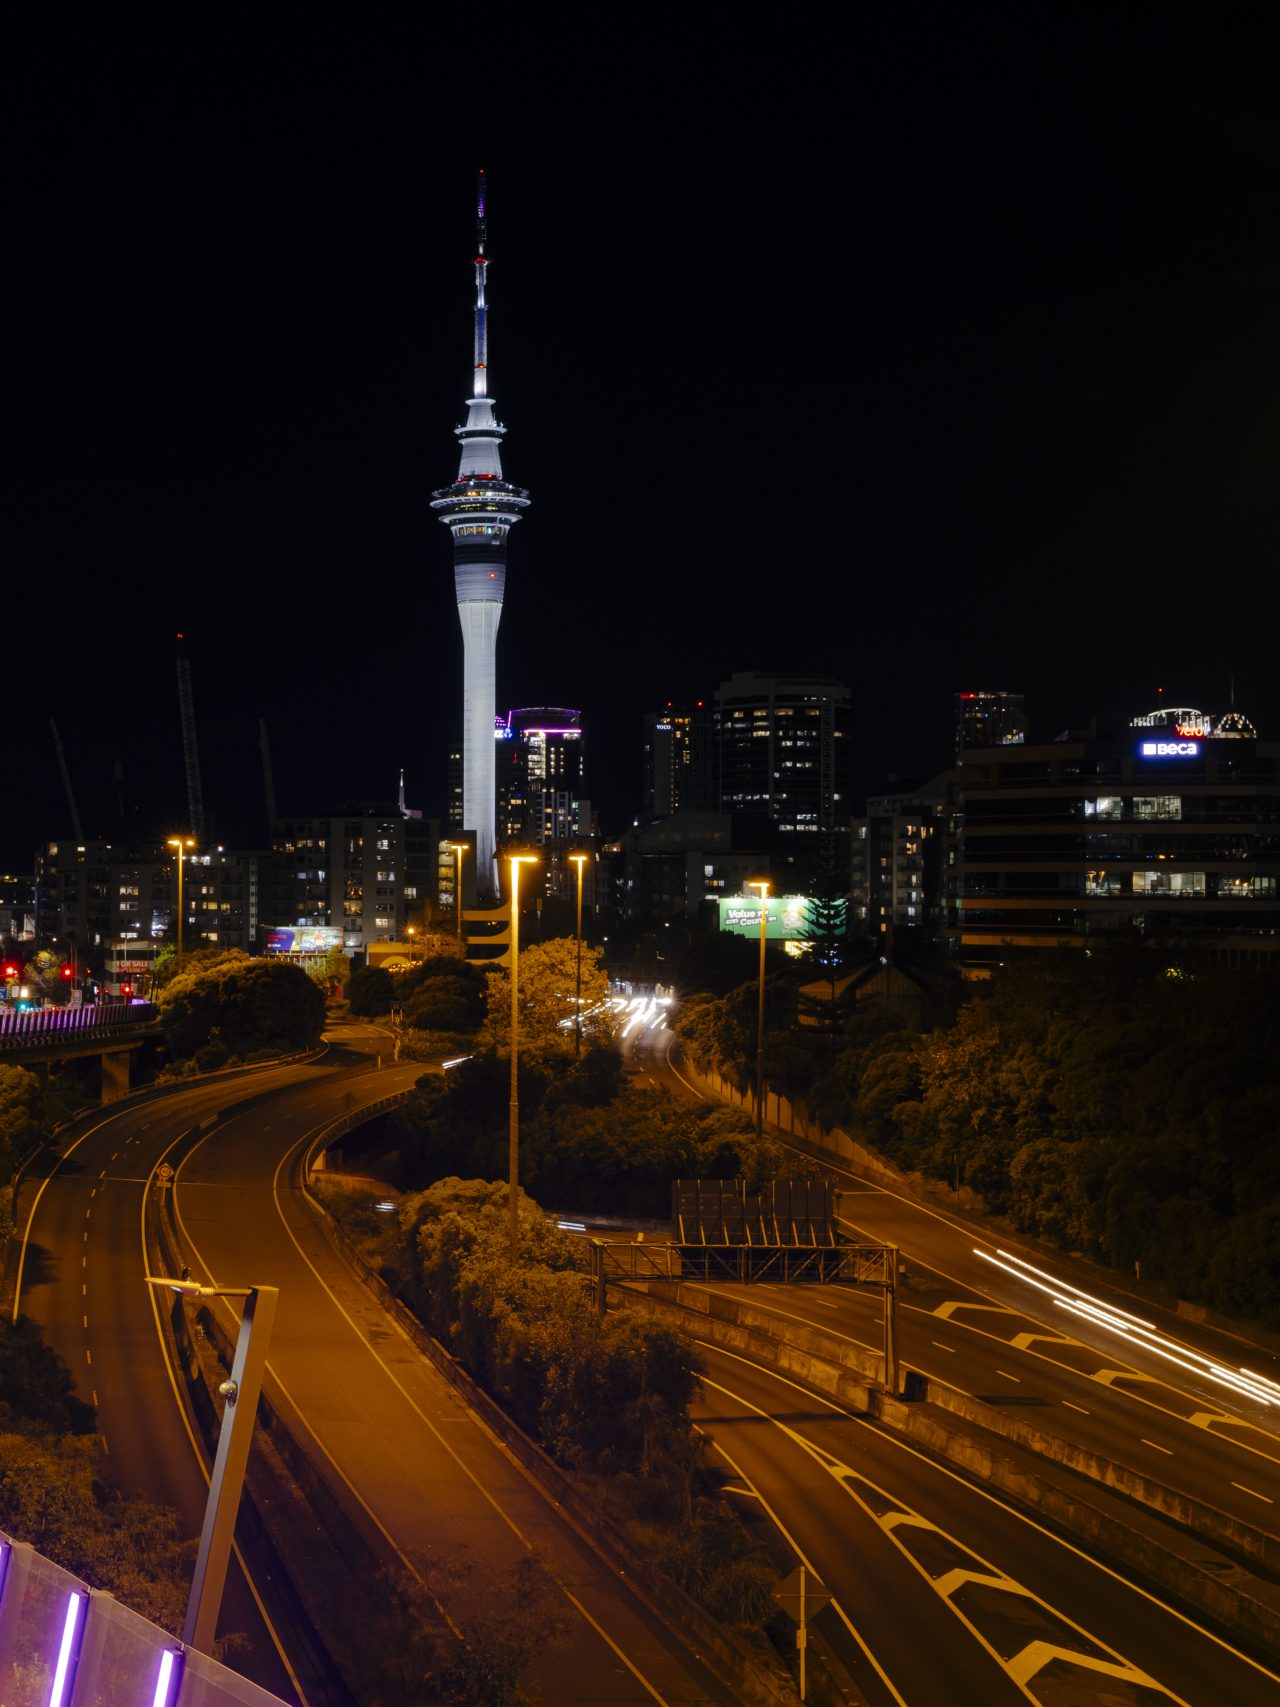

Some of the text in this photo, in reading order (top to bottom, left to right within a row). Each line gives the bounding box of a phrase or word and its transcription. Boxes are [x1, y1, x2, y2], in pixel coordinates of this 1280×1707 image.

[1158, 743, 1197, 755] Beca
[728, 909, 756, 918] Value
[739, 917, 766, 926] Coun
